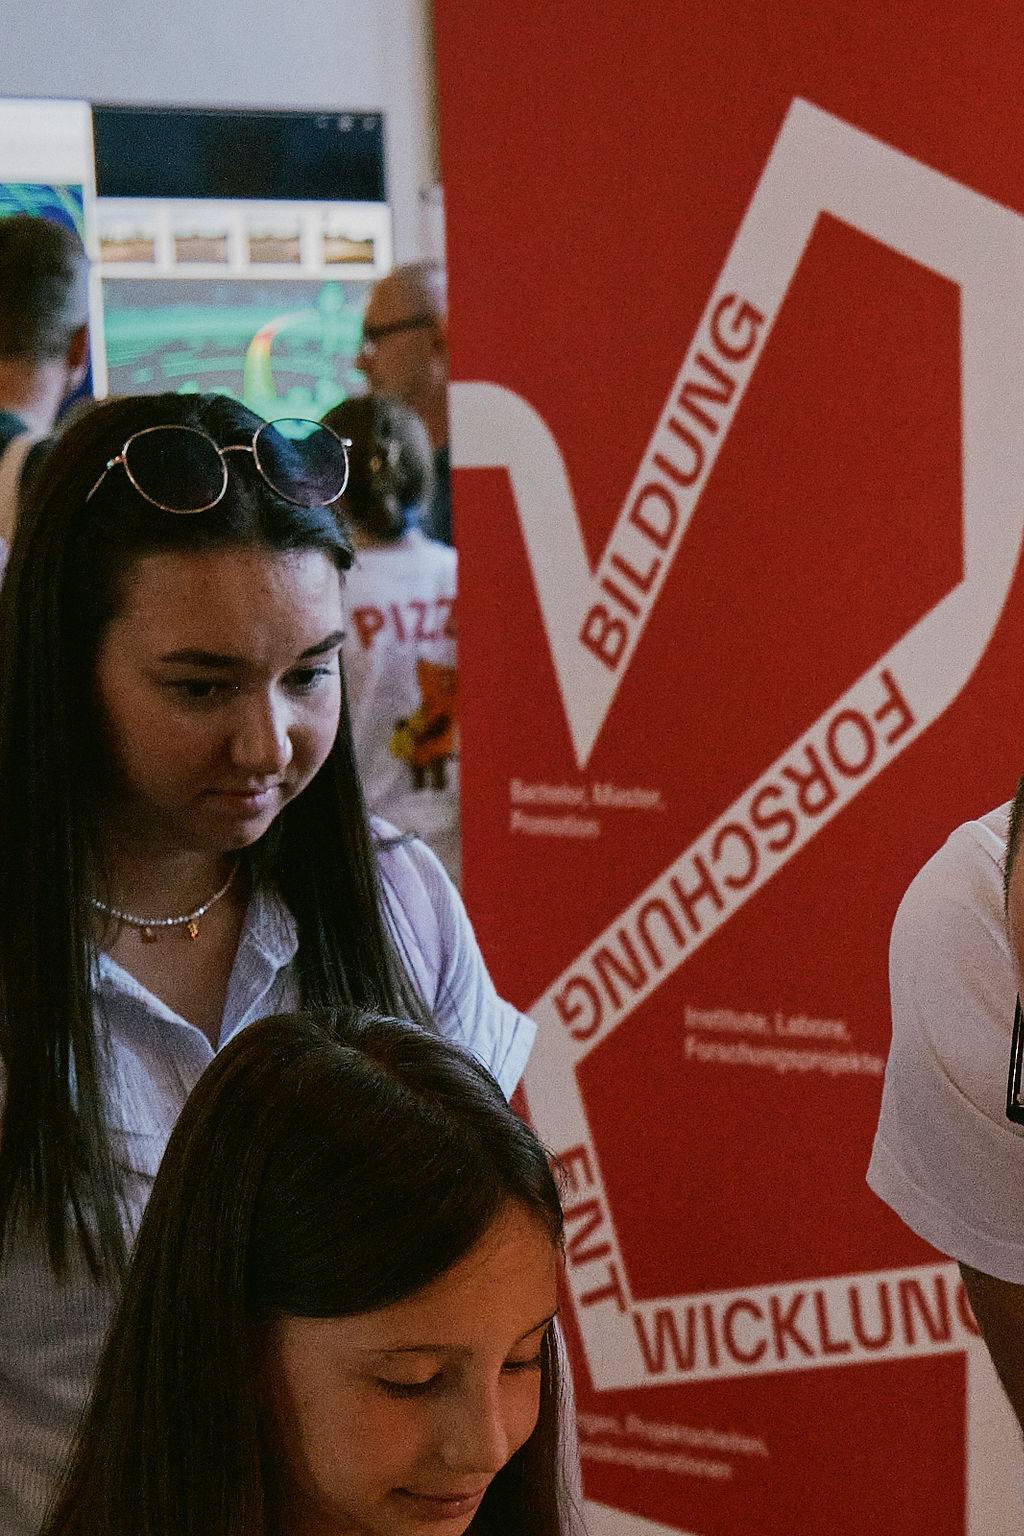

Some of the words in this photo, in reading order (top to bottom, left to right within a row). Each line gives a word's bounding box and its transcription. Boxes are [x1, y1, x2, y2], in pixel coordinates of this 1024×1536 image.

[579, 292, 765, 672] BILDUNG
[552, 667, 917, 1041] FORSCHUNG
[553, 1143, 627, 1314] ENT
